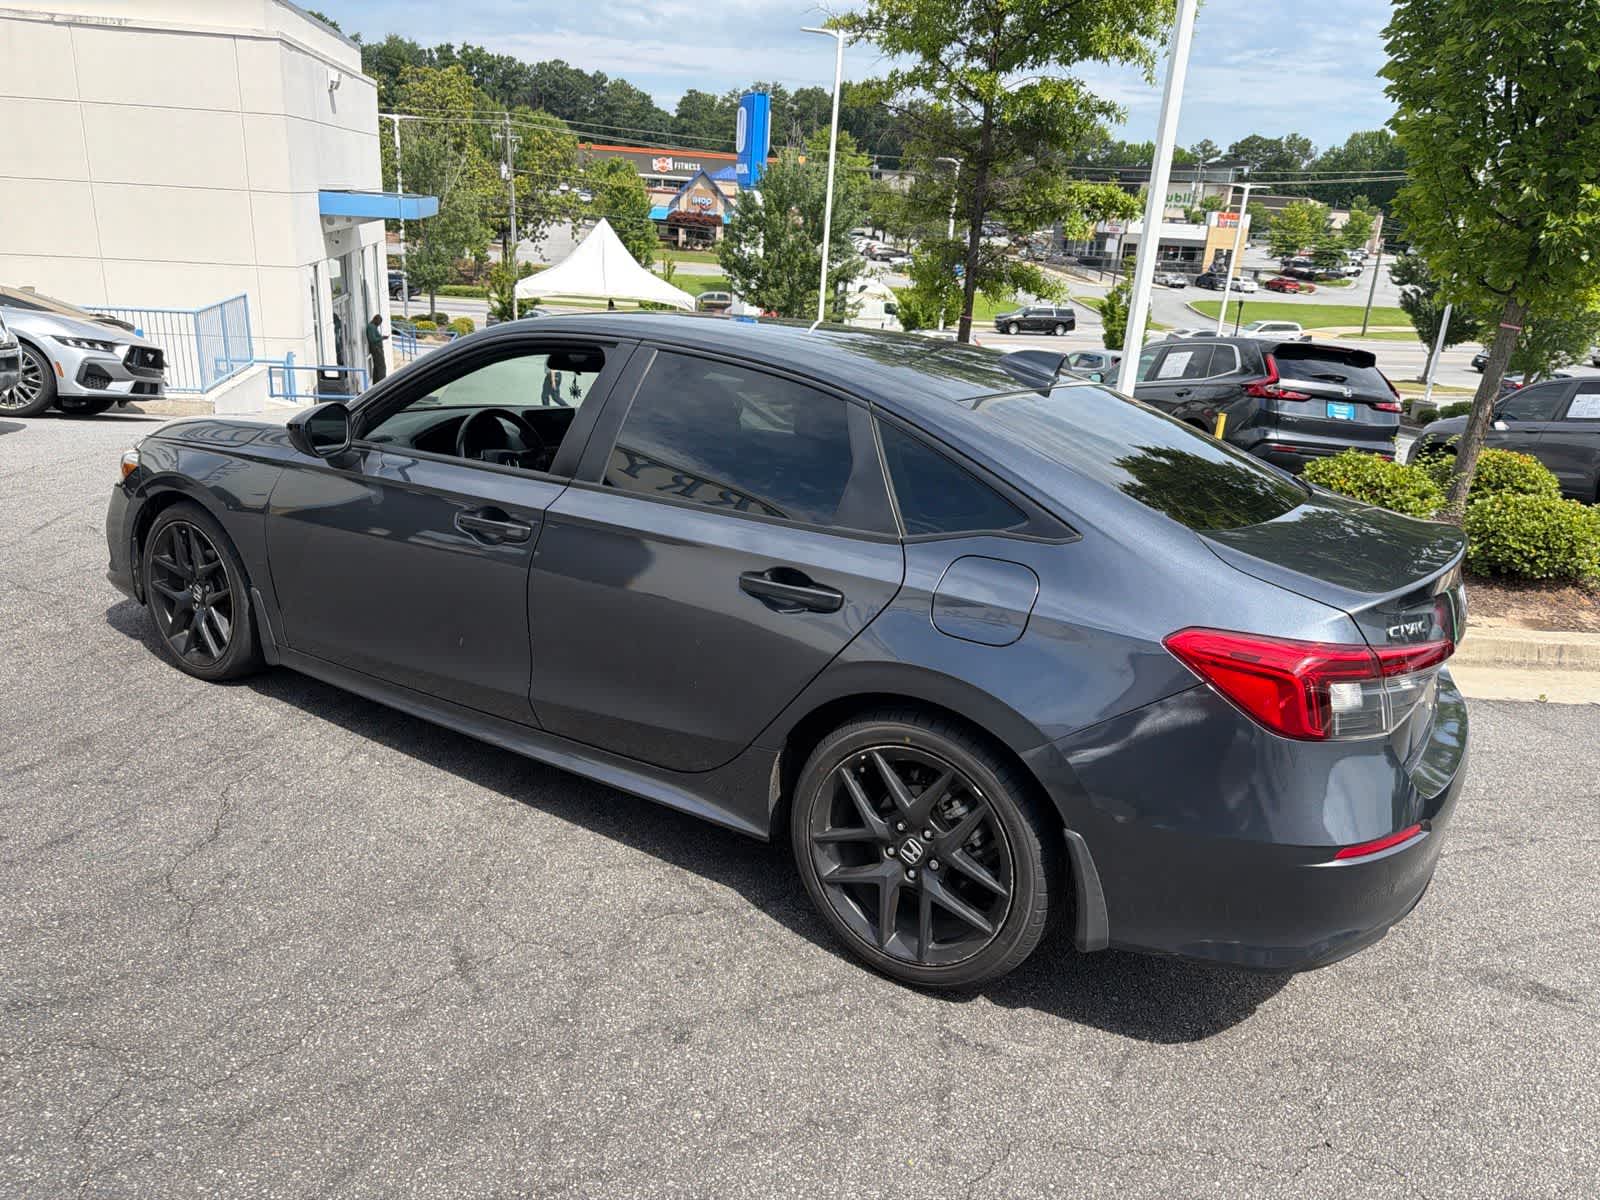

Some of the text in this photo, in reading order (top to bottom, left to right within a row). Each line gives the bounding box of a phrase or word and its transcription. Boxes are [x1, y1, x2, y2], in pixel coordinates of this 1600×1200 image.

[674, 161, 700, 171] FITNESS
[1166, 191, 1198, 204] ubli
[1386, 621, 1426, 637] CIVIC
